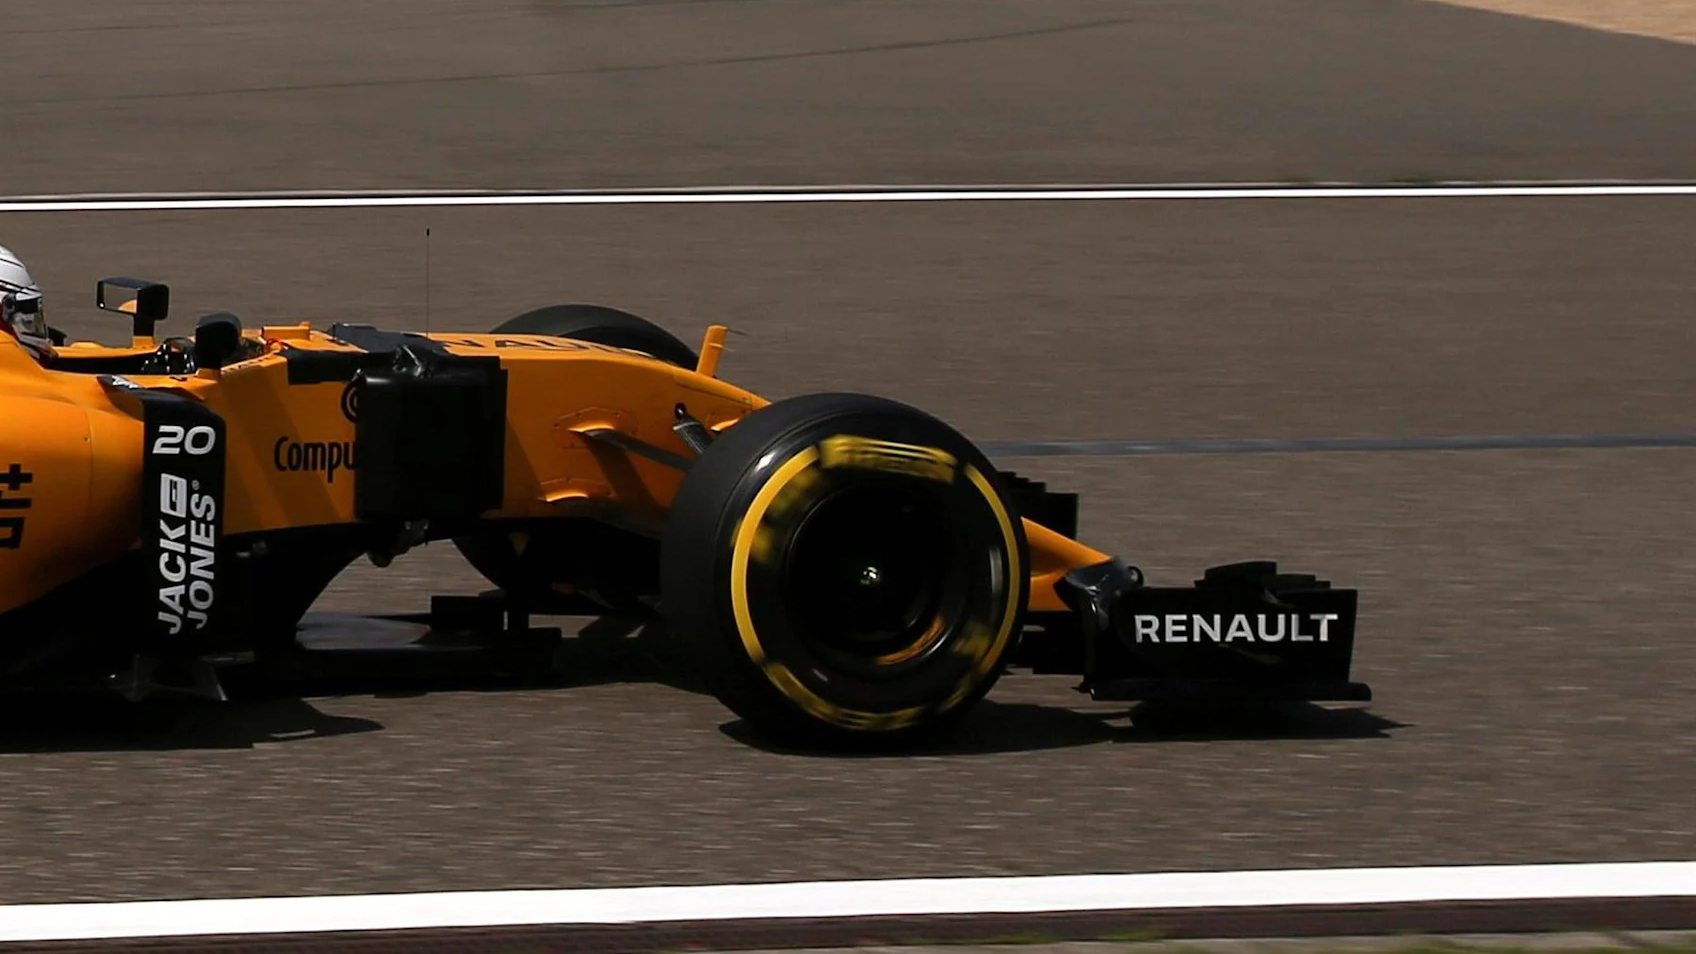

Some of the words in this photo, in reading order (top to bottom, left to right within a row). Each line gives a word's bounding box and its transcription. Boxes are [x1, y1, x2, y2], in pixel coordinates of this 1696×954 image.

[152, 424, 216, 455] 20
[157, 519, 187, 635] JACK
[1134, 613, 1339, 643] RENAULT
